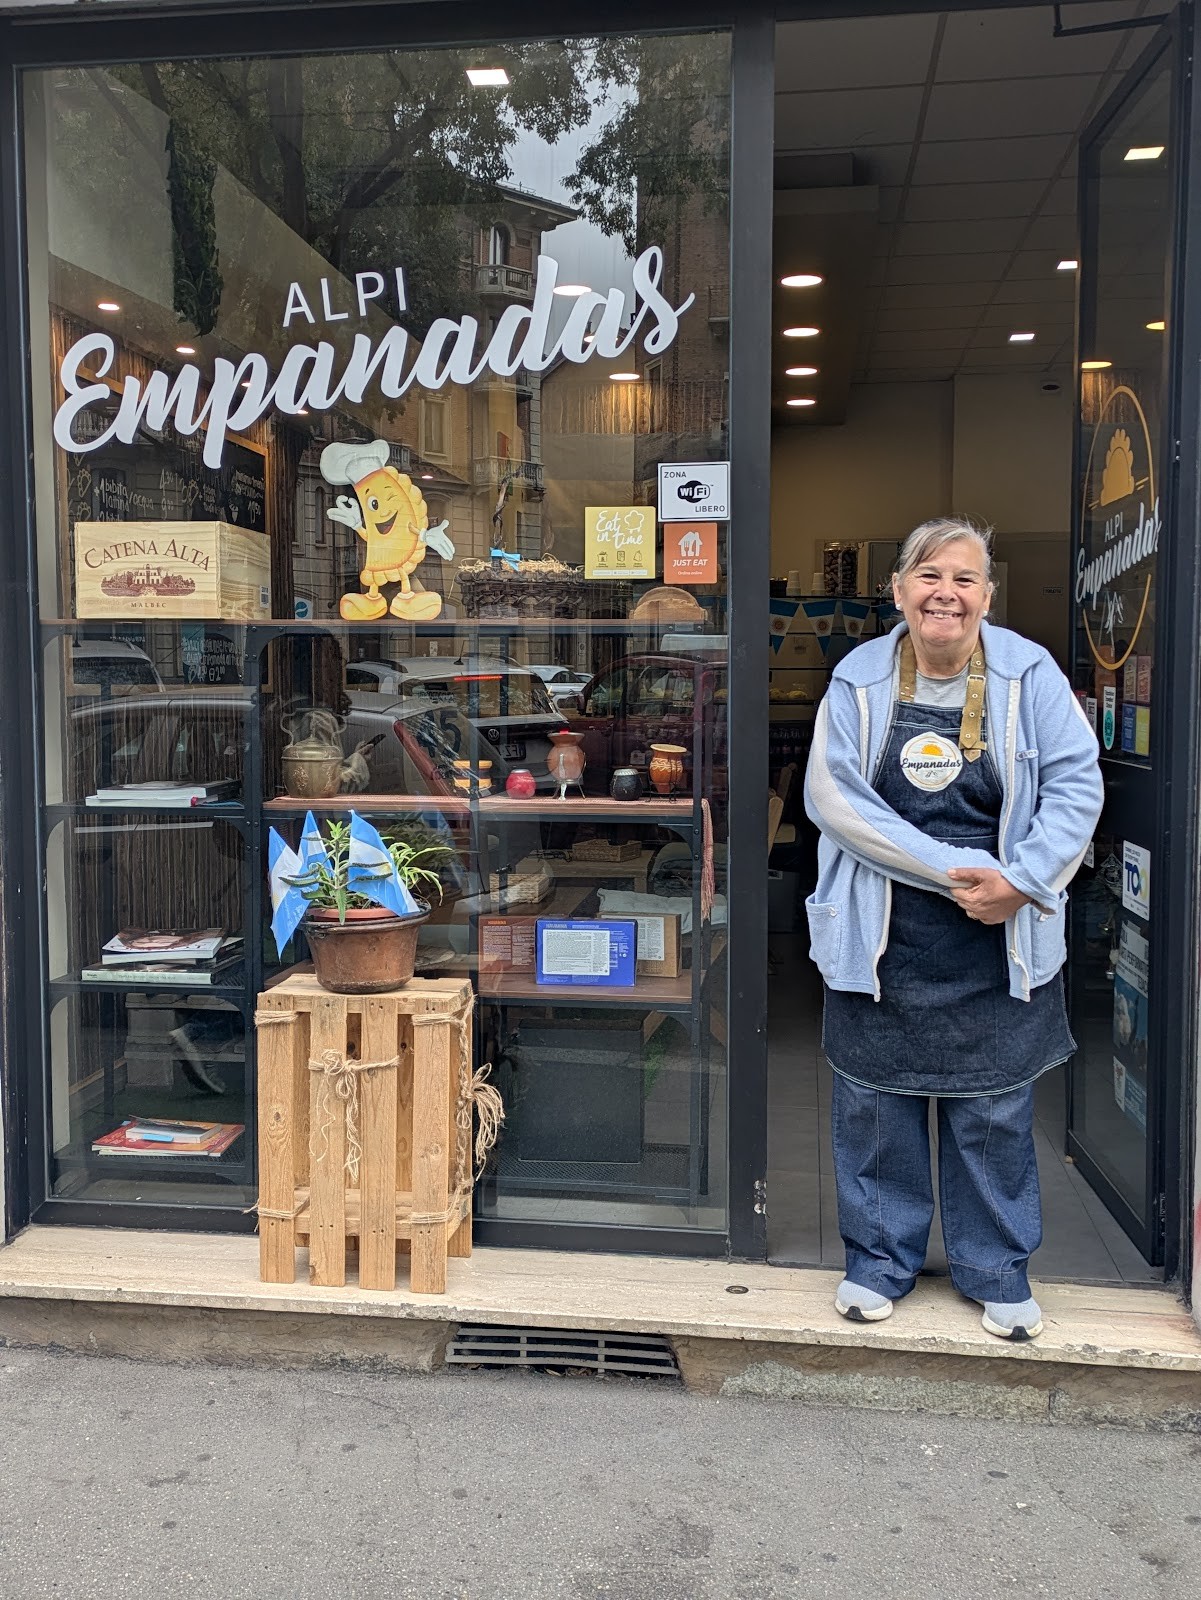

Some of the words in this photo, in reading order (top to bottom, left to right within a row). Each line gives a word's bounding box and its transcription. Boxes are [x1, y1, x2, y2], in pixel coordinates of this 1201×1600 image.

[282, 267, 406, 327] ALPI
[53, 246, 695, 469] Empanadas
[596, 510, 621, 532] Eat
[695, 505, 726, 513] LIBERO
[597, 530, 610, 543] in
[613, 525, 644, 549] time
[1104, 511, 1123, 542] ALPI
[84, 540, 159, 569] CATENA
[162, 539, 210, 572] ALTA
[673, 559, 692, 567] JUST
[693, 558, 709, 566] EAT
[1075, 496, 1162, 610] Empanadas
[901, 757, 962, 773] Empanadas
